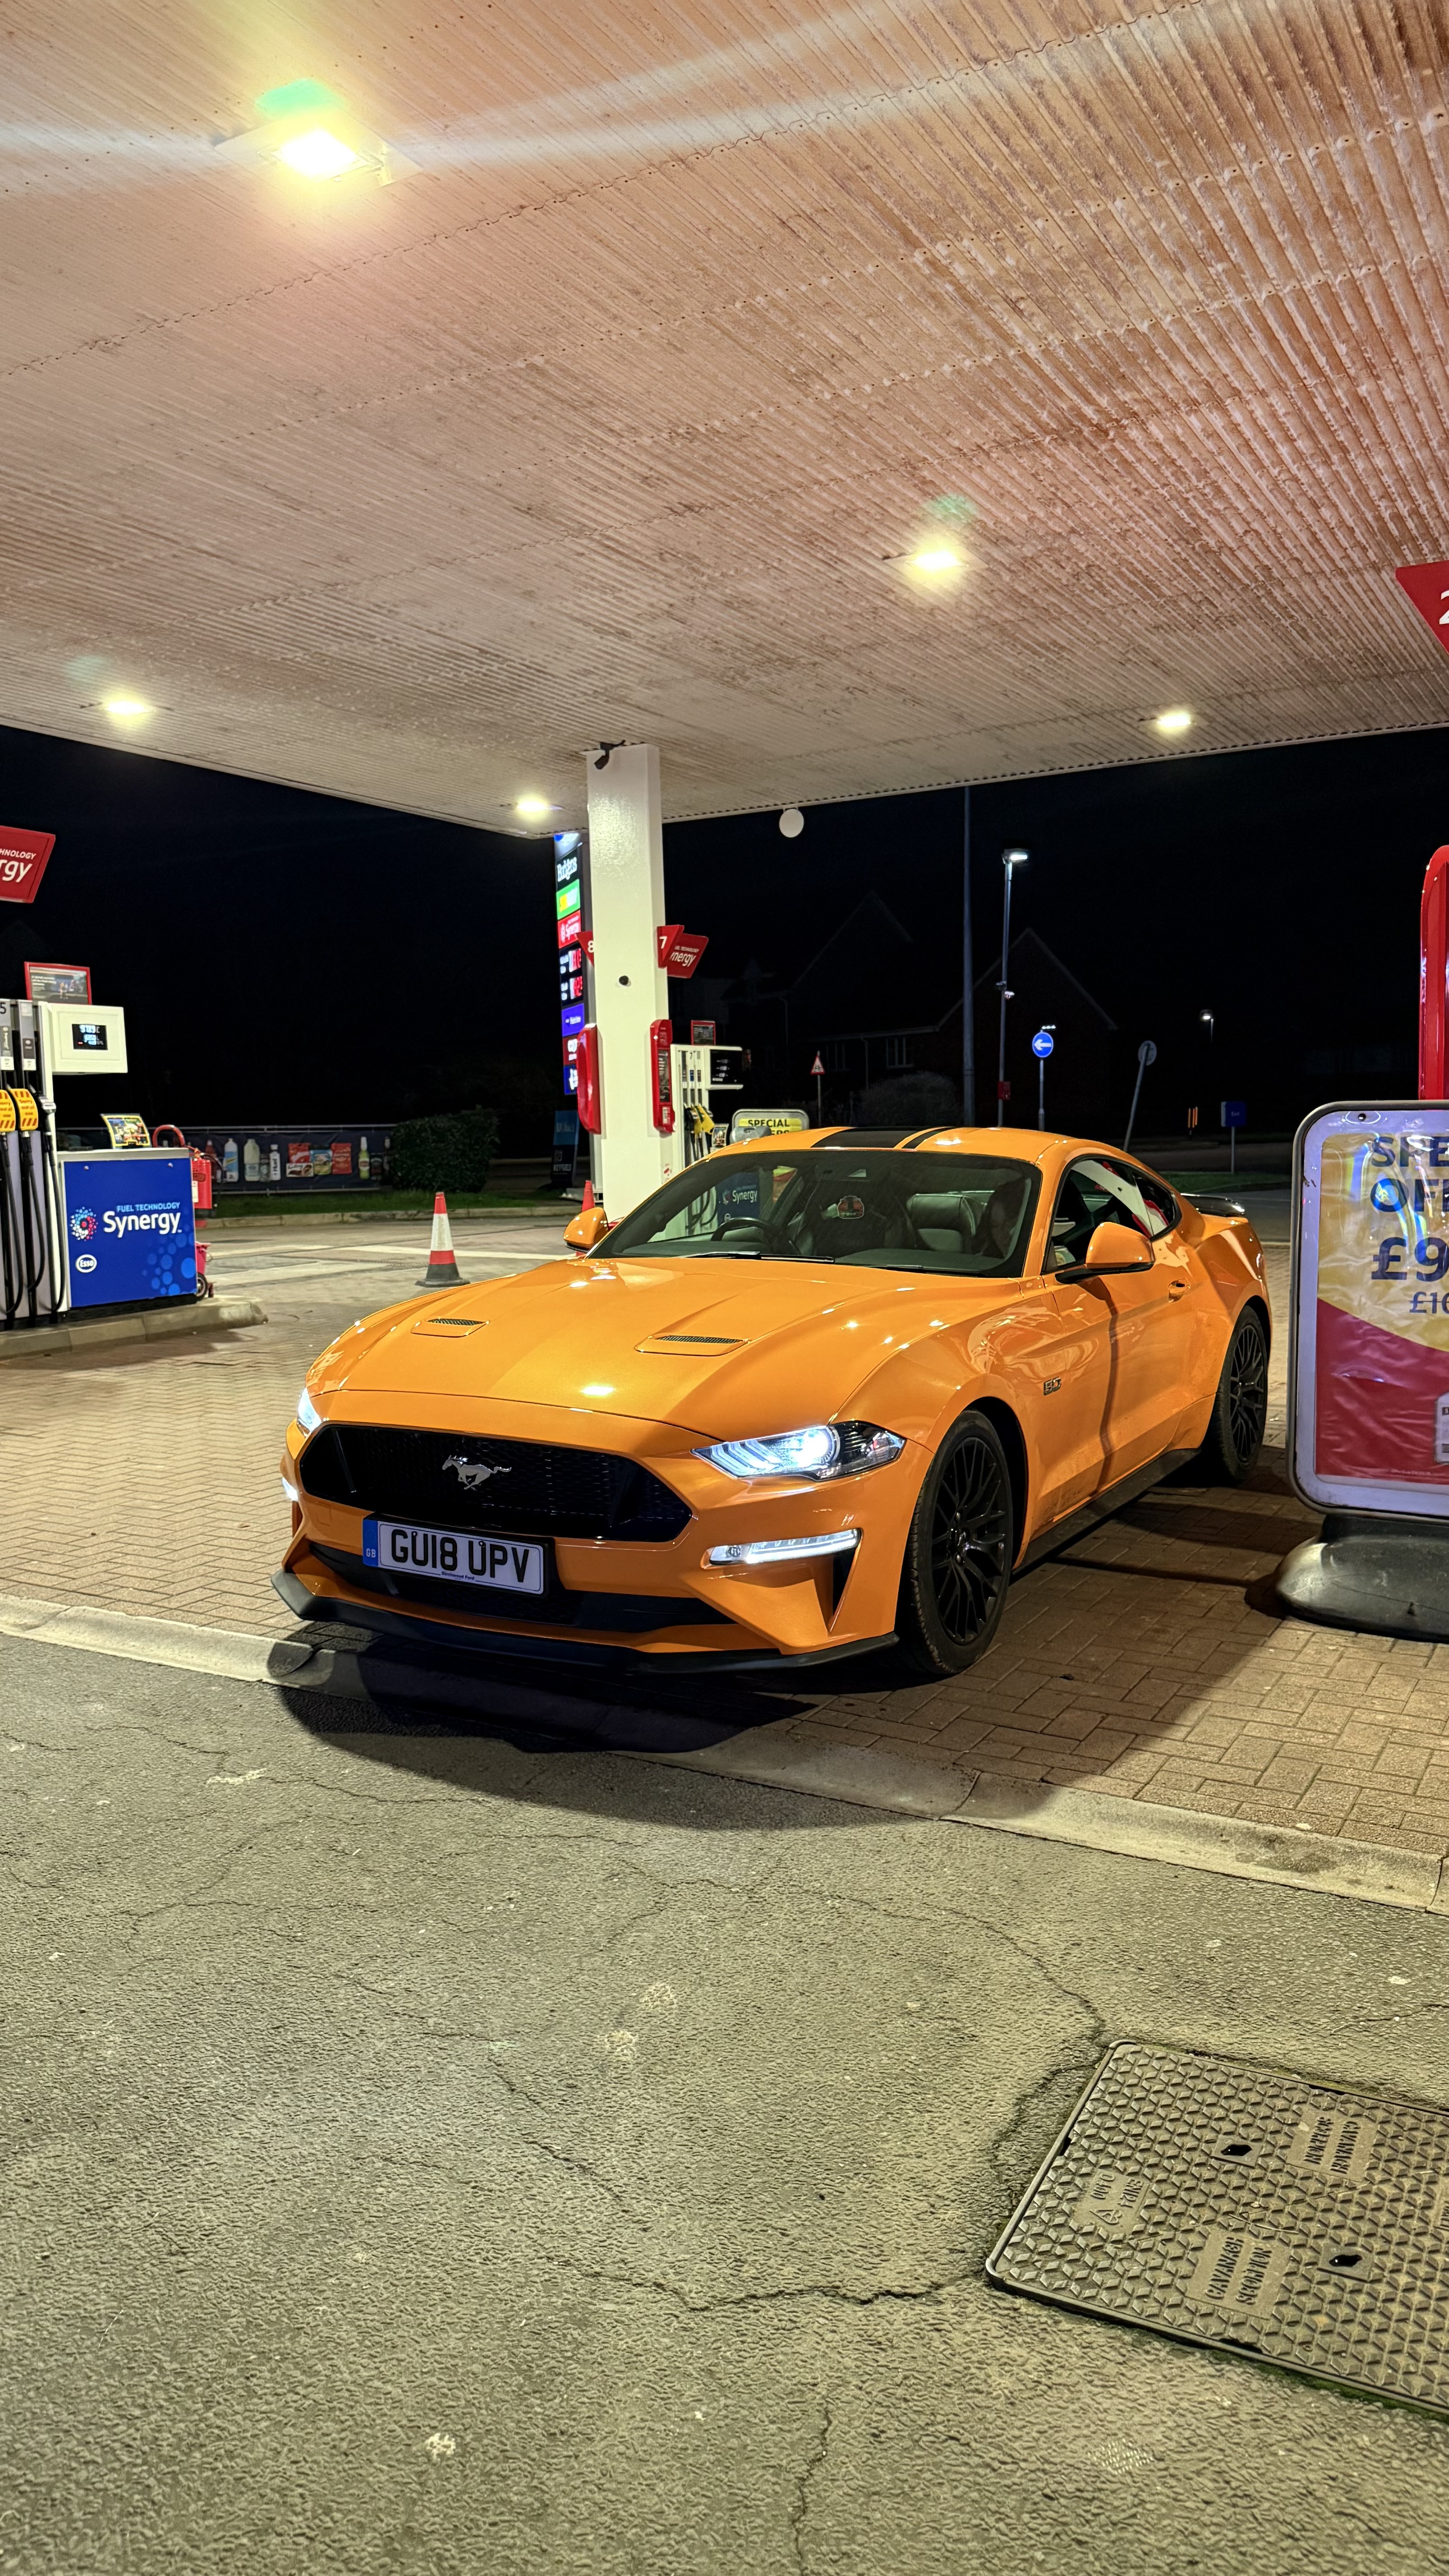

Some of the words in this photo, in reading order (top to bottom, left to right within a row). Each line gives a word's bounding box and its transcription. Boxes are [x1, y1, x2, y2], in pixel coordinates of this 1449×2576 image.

[588, 940, 594, 953] 8
[659, 936, 667, 949] 7
[0, 1003, 6, 1014] 5
[748, 1119, 790, 1127] SPECIAL
[732, 1190, 758, 1205] Synergy
[1370, 1178, 1449, 1212] OF
[135, 1202, 180, 1212] TECHNOLOGY
[103, 1210, 181, 1238] Synergy
[366, 1548, 376, 1558] GB
[391, 1529, 458, 1572] GU18
[468, 1540, 529, 1583] UPV
[1205, 2236, 1245, 2300] CAVANAGH
[1235, 2247, 1272, 2305] SCORPION
